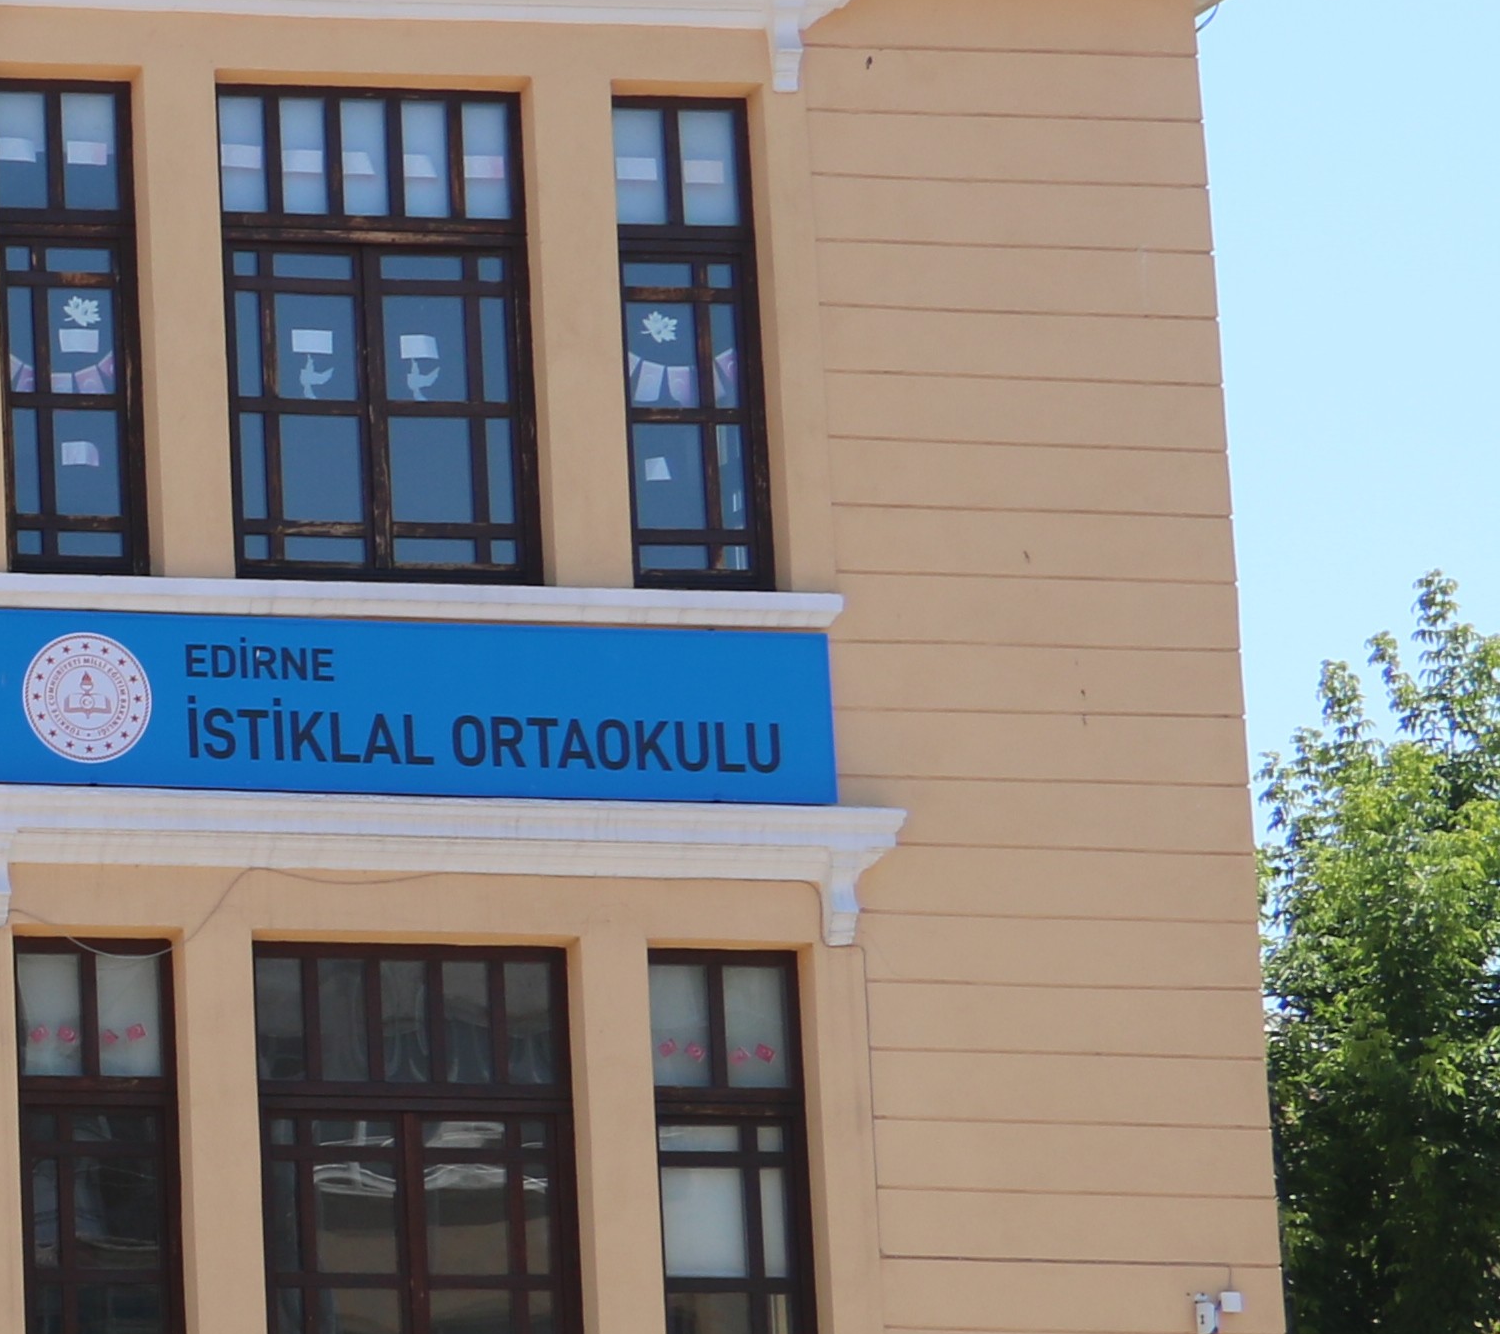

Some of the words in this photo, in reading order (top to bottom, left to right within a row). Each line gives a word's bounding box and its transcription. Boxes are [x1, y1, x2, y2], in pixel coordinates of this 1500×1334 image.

[185, 636, 335, 682] EDİRNE
[187, 695, 435, 765] İSTİKLAL
[452, 714, 782, 774] ORTAOKULU
